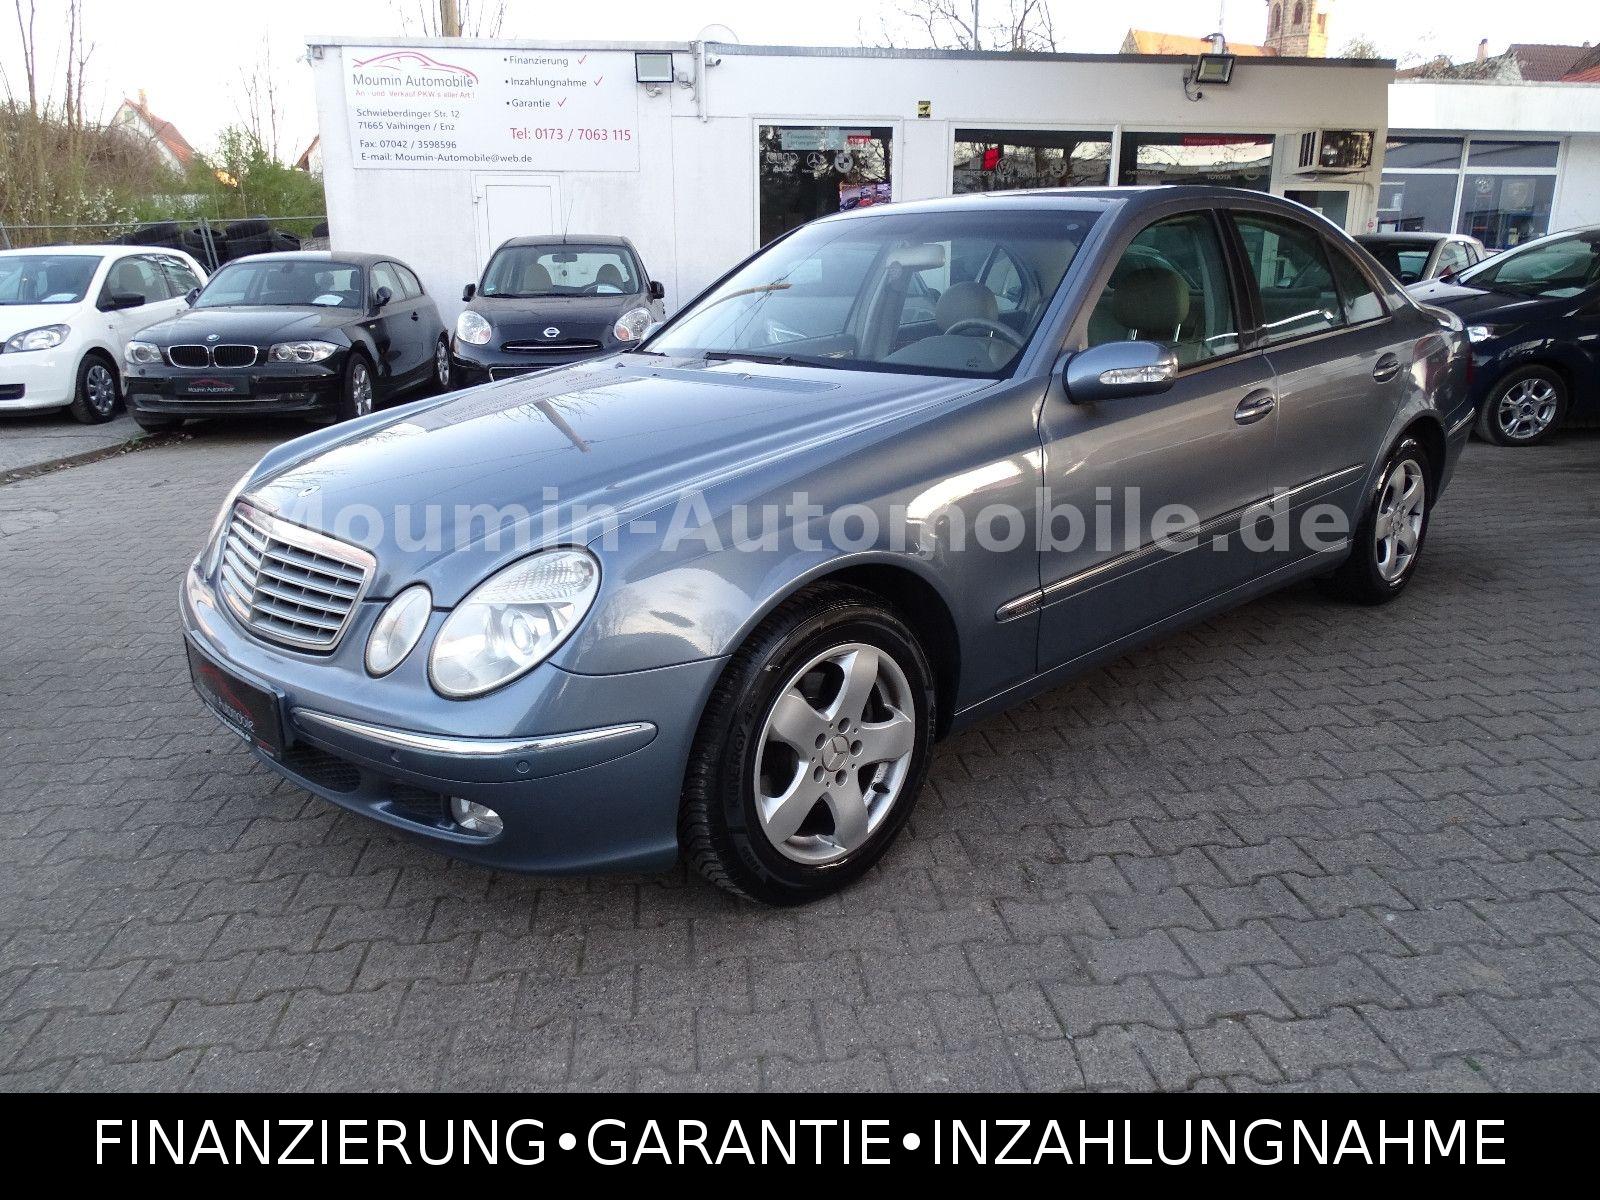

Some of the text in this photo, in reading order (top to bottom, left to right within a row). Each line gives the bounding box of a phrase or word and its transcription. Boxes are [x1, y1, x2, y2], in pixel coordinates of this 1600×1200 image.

[509, 55, 569, 67] Finanzierung
[352, 74, 474, 88] Moumin Automobile
[510, 77, 587, 88] Inzahlungnahme
[511, 99, 551, 108] Garantie
[356, 109, 460, 119] Schwieberdinger Str. 12
[358, 121, 384, 130] 71665
[386, 122, 431, 133] Vaihingen
[440, 123, 455, 131] Enz
[510, 127, 531, 140] Tel:
[534, 128, 563, 140] 0173
[577, 128, 608, 141] 7063
[612, 129, 632, 141] 115
[359, 139, 377, 149] Fax:
[379, 140, 408, 149] 07042
[418, 140, 457, 149] 3598596
[361, 152, 533, 163] E-mail: Moumin-Automobile@web.de
